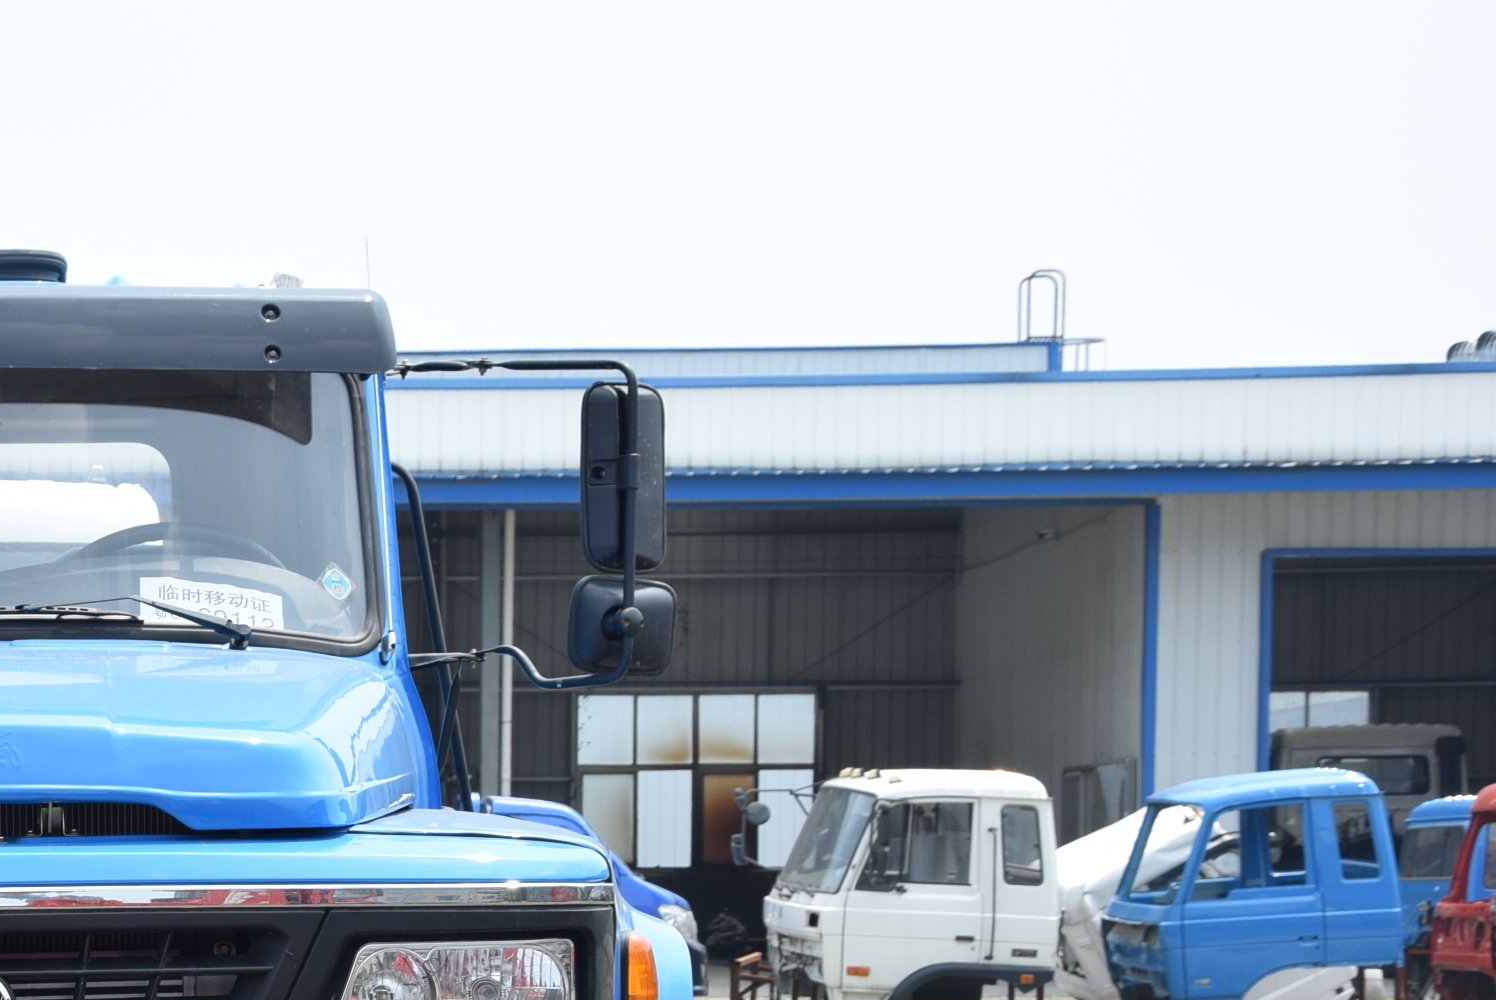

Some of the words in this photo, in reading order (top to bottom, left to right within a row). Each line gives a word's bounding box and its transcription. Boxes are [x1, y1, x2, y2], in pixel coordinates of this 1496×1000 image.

[158, 584, 272, 613] 临时移动证
